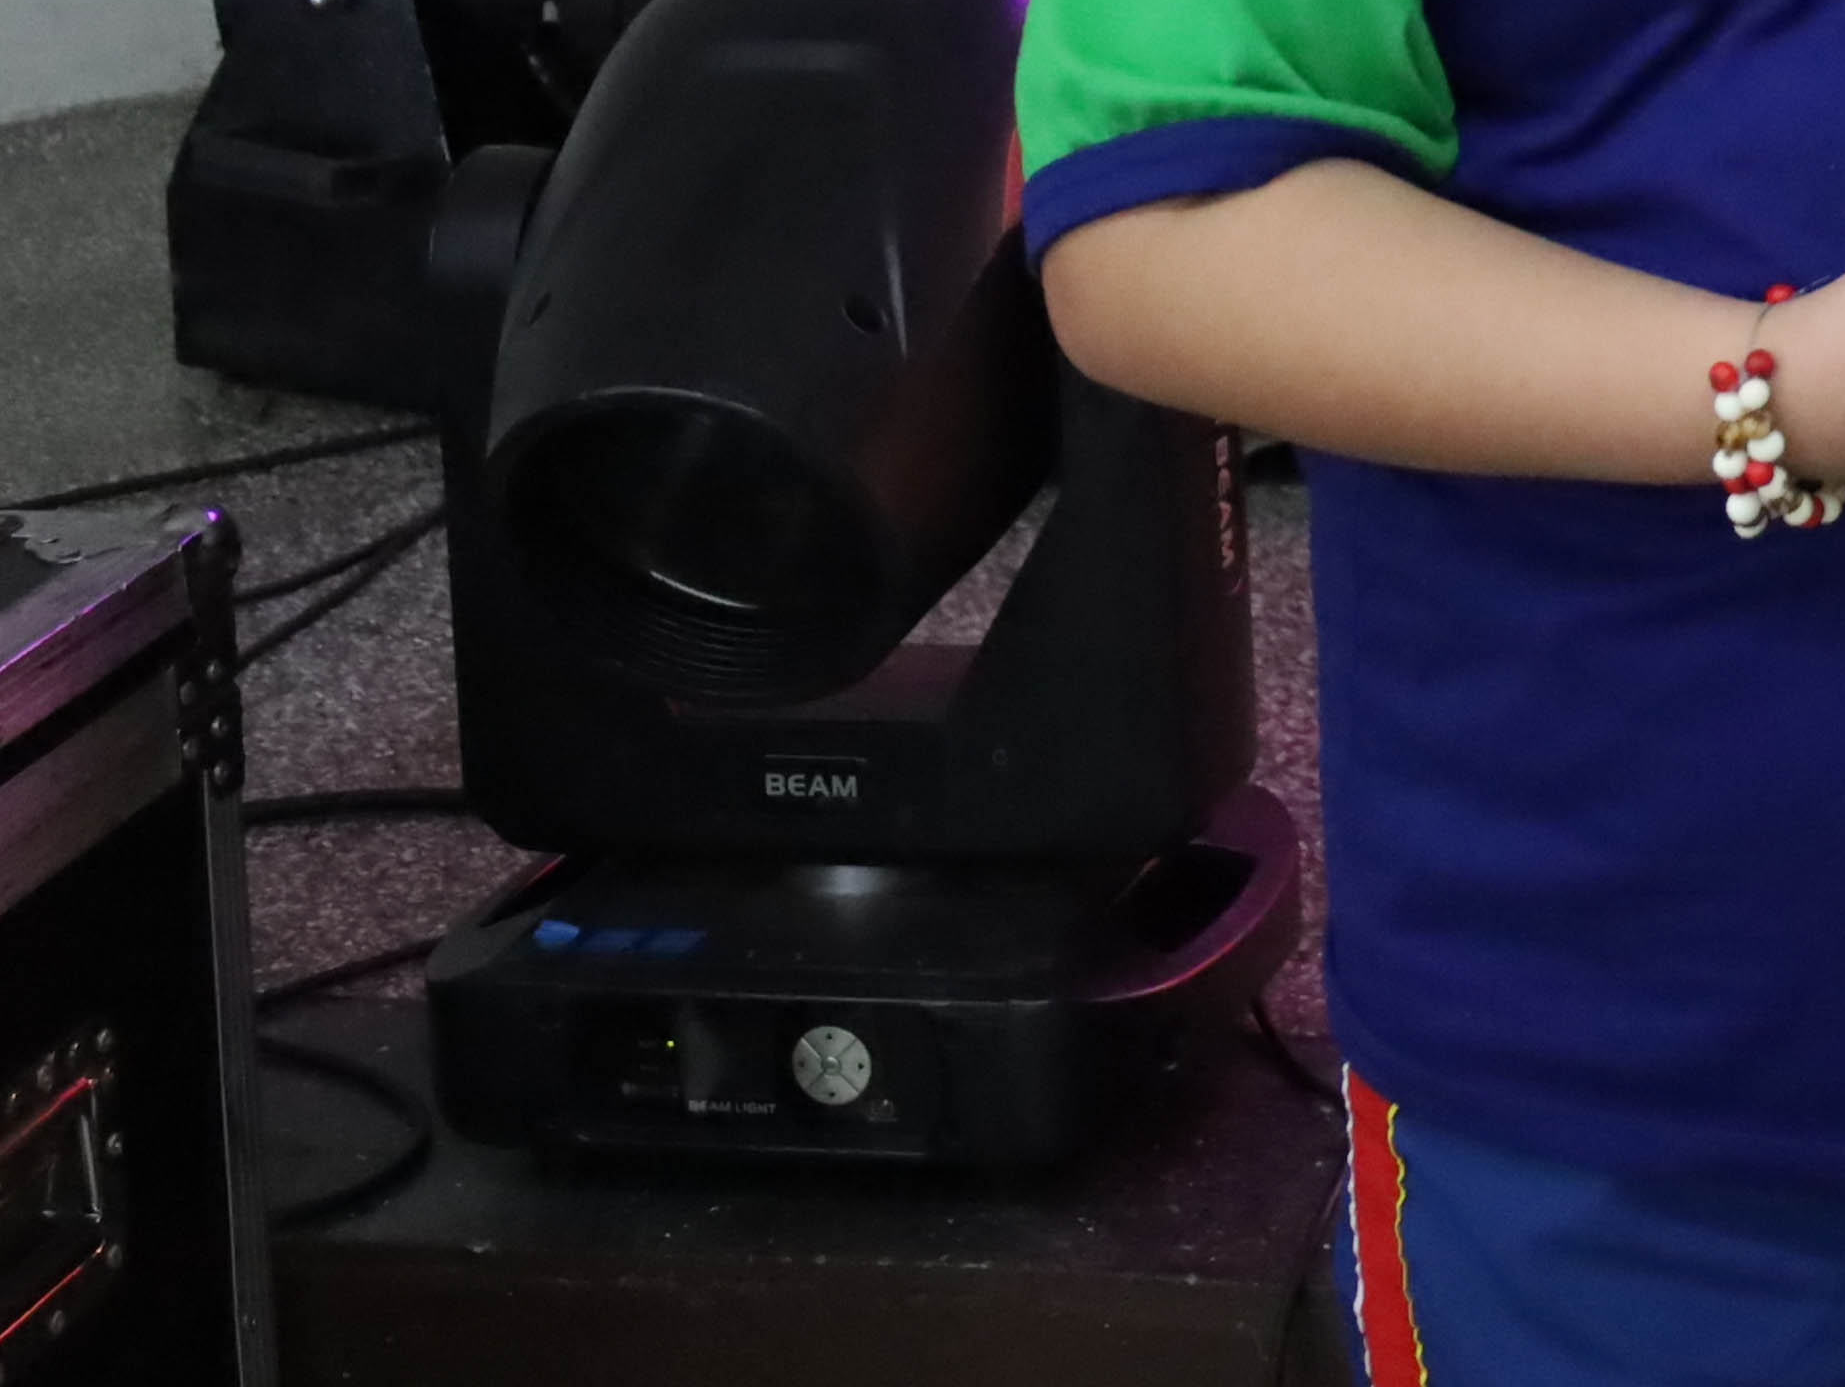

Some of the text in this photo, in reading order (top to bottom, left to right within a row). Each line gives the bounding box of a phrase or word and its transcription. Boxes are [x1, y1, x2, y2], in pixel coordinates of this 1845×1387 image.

[764, 772, 858, 799] BEAM
[688, 1099, 777, 1115] BEAM LIGHT
